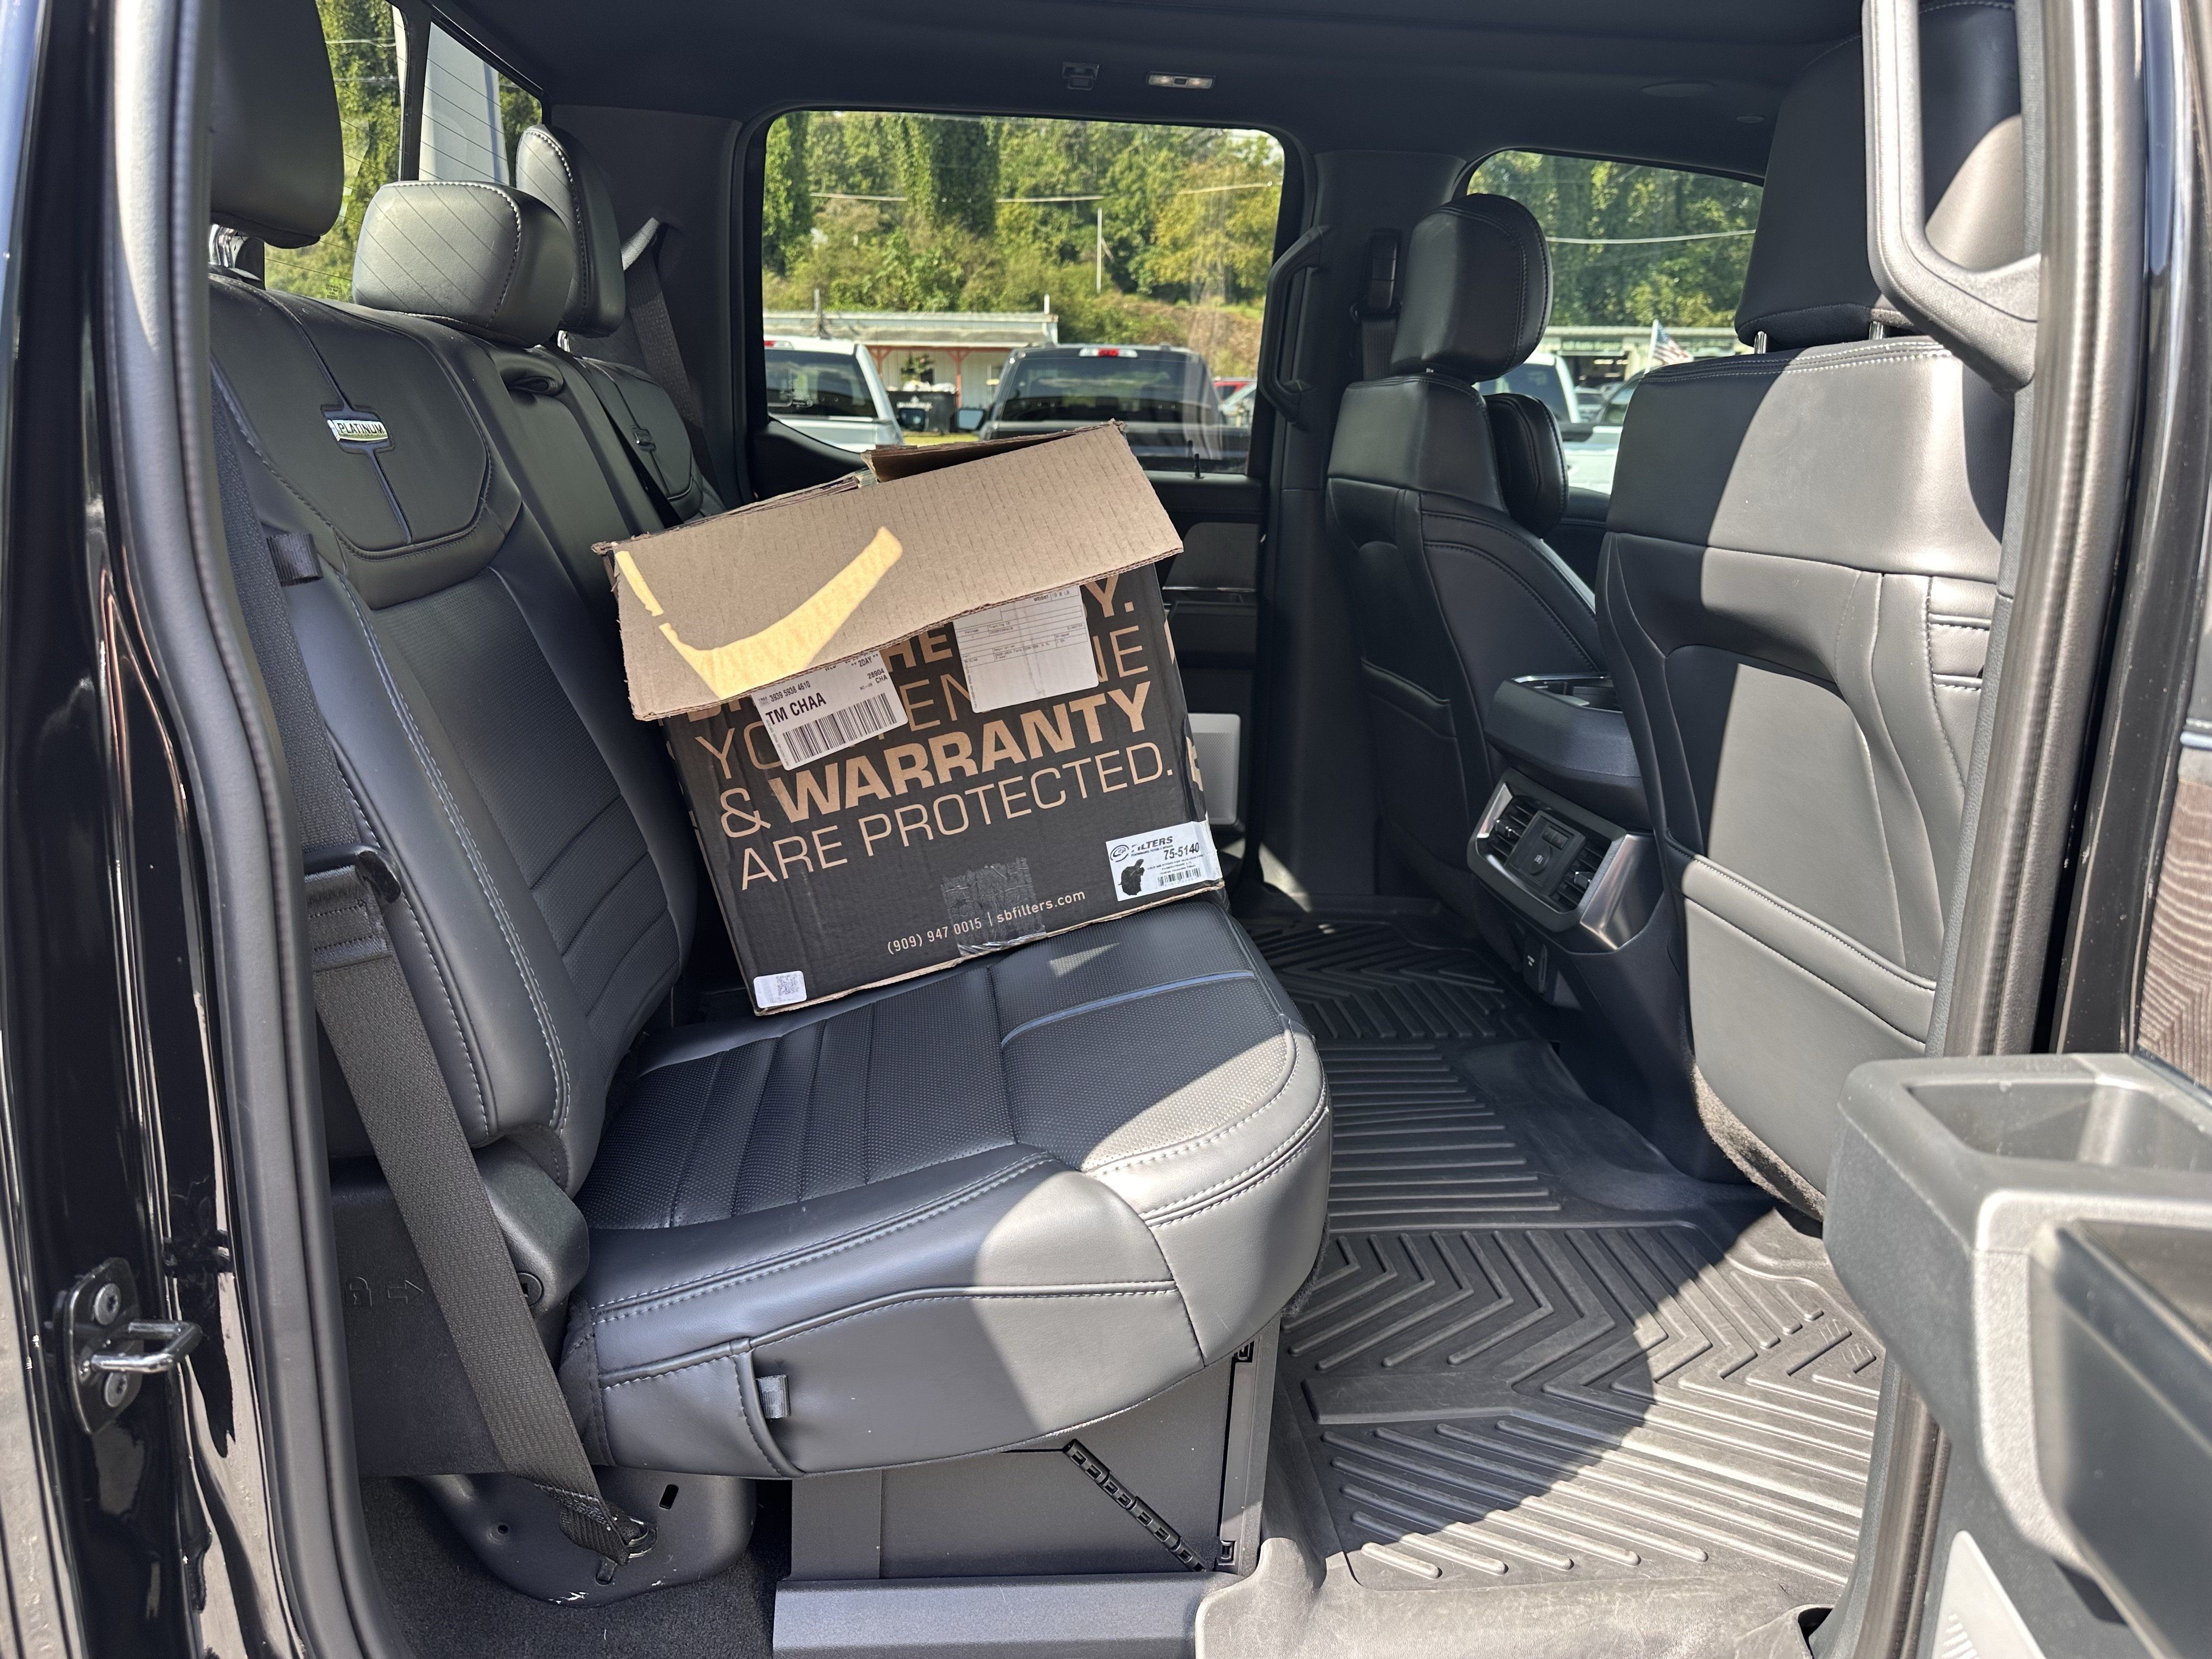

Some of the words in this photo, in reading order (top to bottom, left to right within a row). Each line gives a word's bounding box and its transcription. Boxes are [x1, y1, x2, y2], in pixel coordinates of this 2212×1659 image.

[337, 423, 385, 433] PLATINUM
[858, 658, 873, 668] 2DAY
[867, 668, 885, 680] 28904
[875, 675, 888, 684] CHA
[769, 691, 783, 702] 3939
[783, 686, 797, 697] 5938
[797, 680, 811, 692] 4610
[765, 707, 788, 725] TM
[789, 692, 827, 716] CHAA
[720, 787, 771, 838] &
[768, 681, 1151, 823] WARRANTY
[742, 825, 848, 891] ARE
[858, 742, 1173, 856] PROTECTED.
[1164, 842, 1200, 860] 75-5140
[887, 933, 923, 955] (909)
[927, 926, 949, 943] 947
[953, 917, 982, 935] 0015
[996, 890, 1086, 923] sbfilters.com
